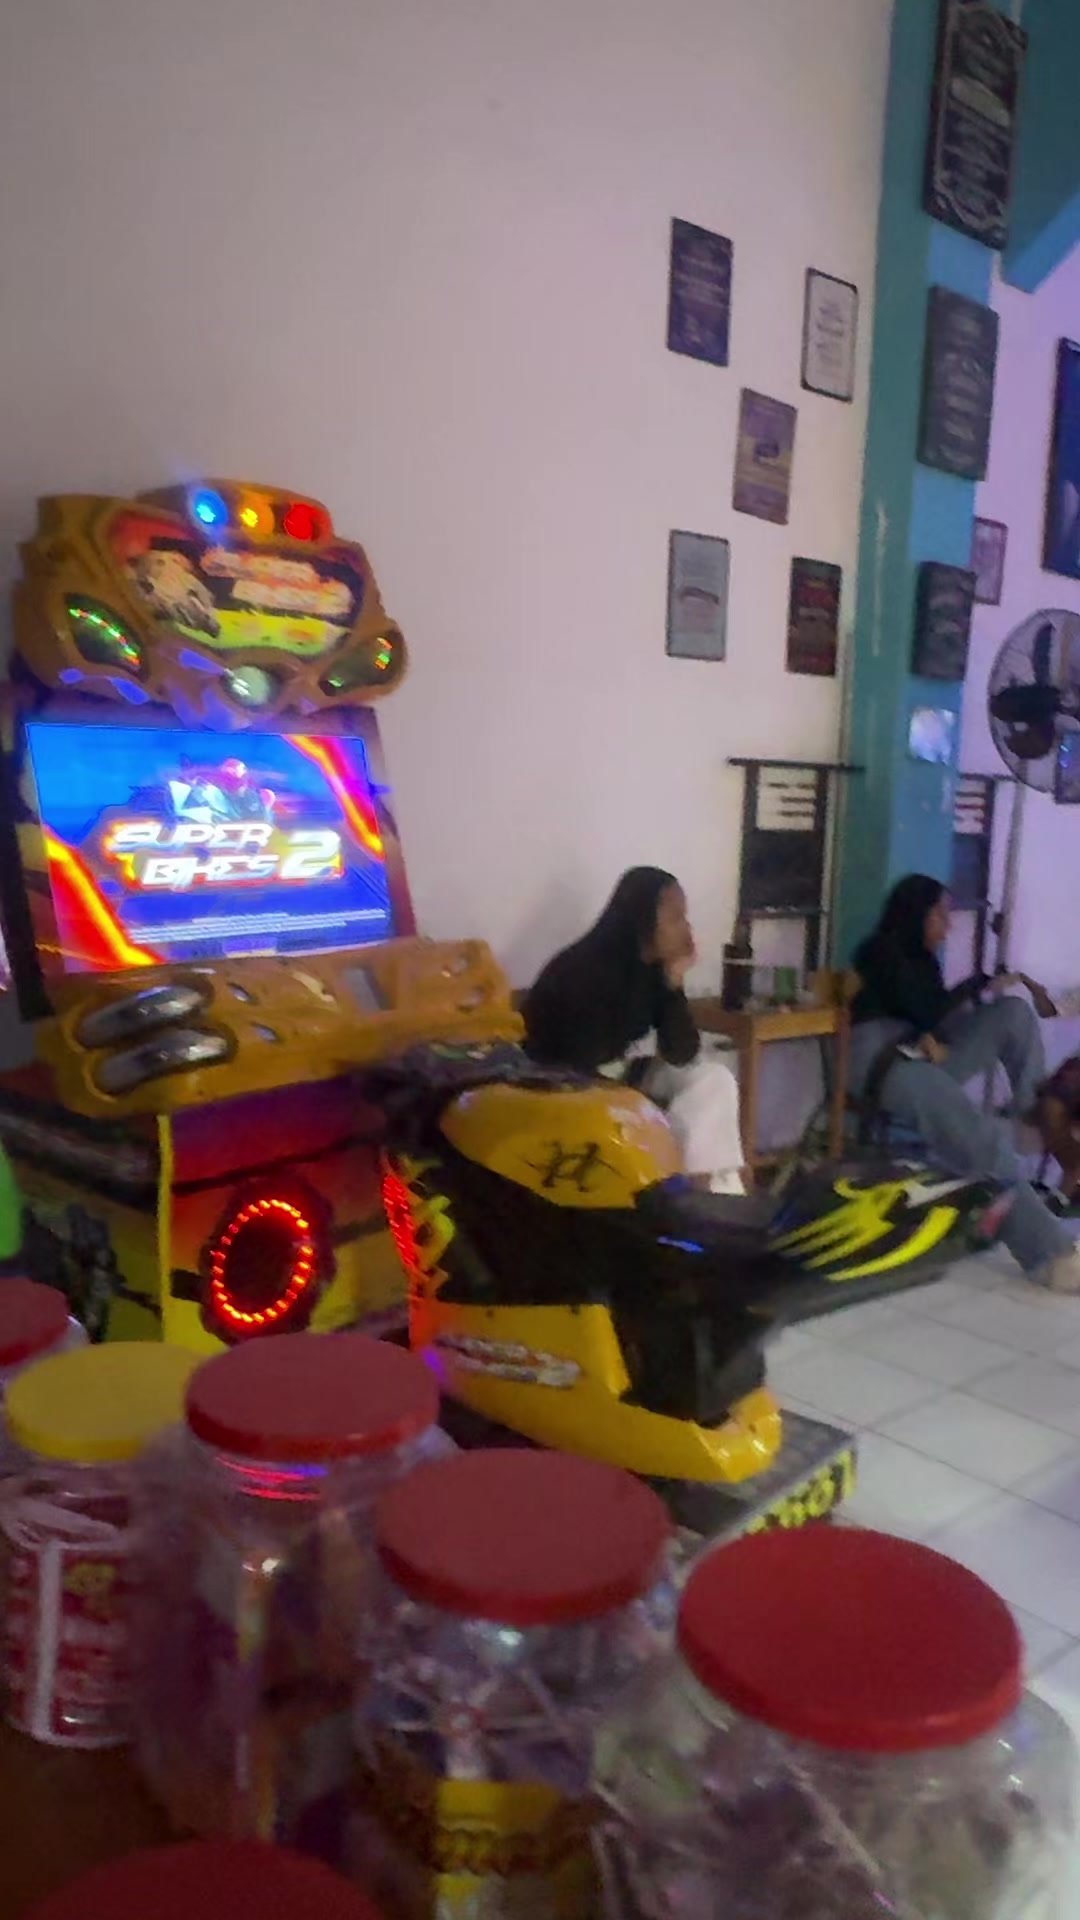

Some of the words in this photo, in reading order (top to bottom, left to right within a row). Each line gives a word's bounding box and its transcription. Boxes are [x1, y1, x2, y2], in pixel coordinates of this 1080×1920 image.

[111, 822, 275, 850] SUPER
[141, 854, 279, 889] BIKES
[279, 829, 341, 879] 2
